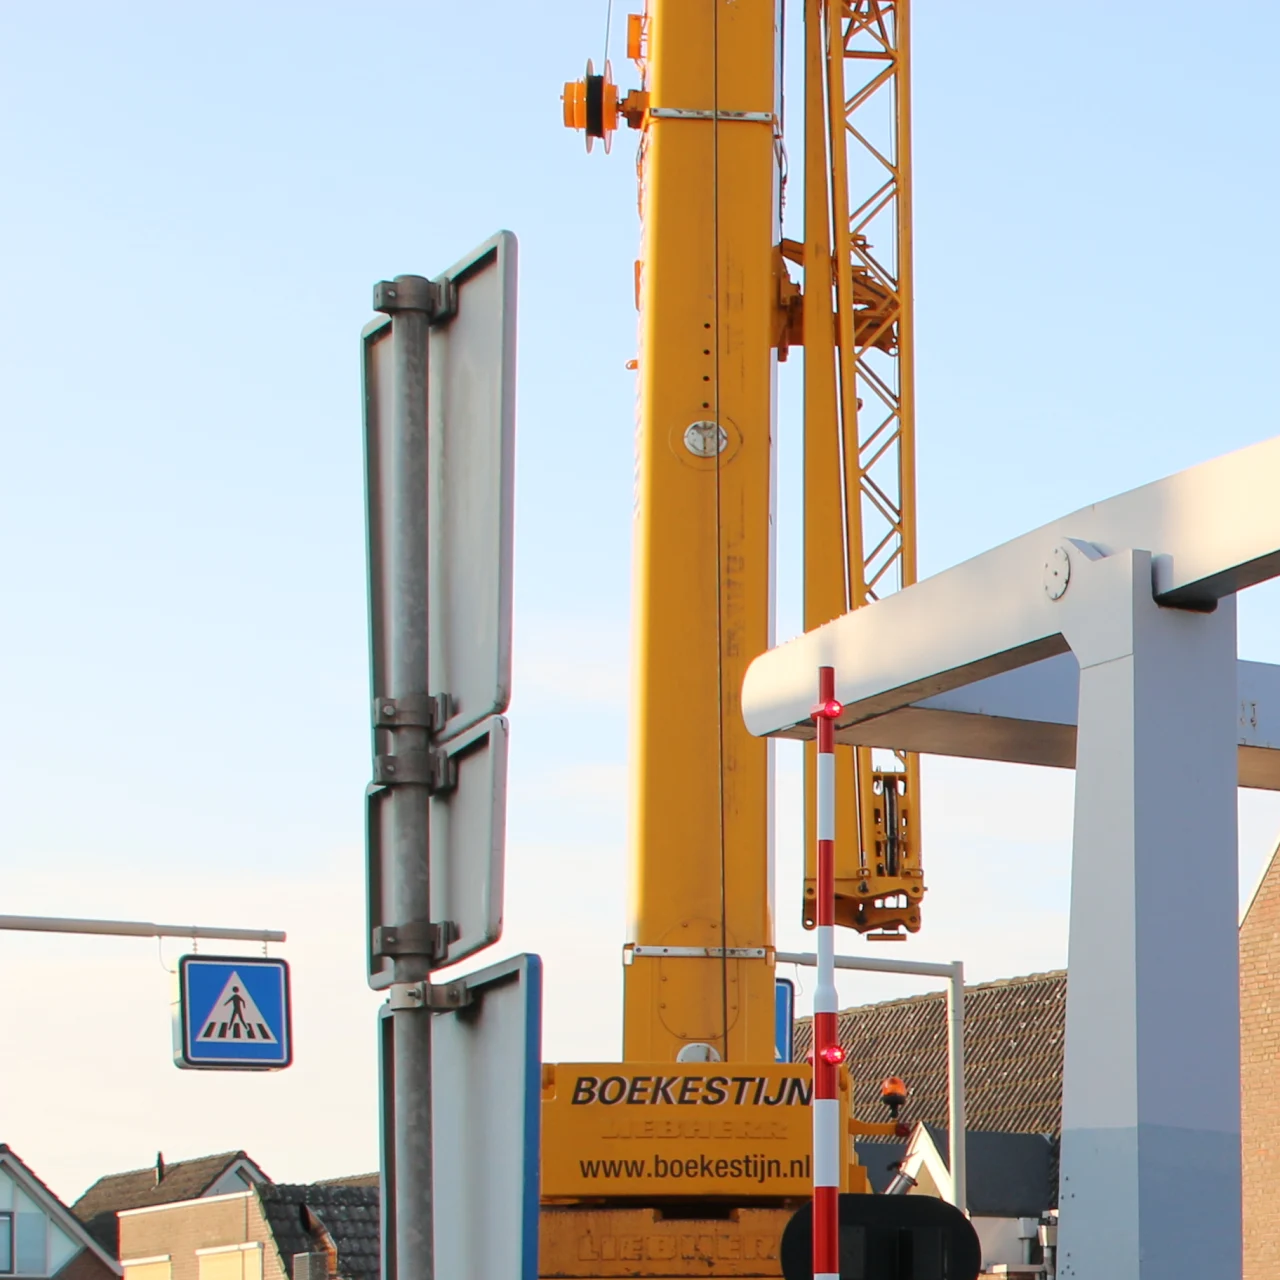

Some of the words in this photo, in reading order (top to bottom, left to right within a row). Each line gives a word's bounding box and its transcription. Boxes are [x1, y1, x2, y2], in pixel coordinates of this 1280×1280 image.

[571, 1076, 813, 1106] BOEKESTIJN
[580, 1155, 810, 1183] www.boekestijn.nl
[578, 1234, 779, 1262] LIEBHER
